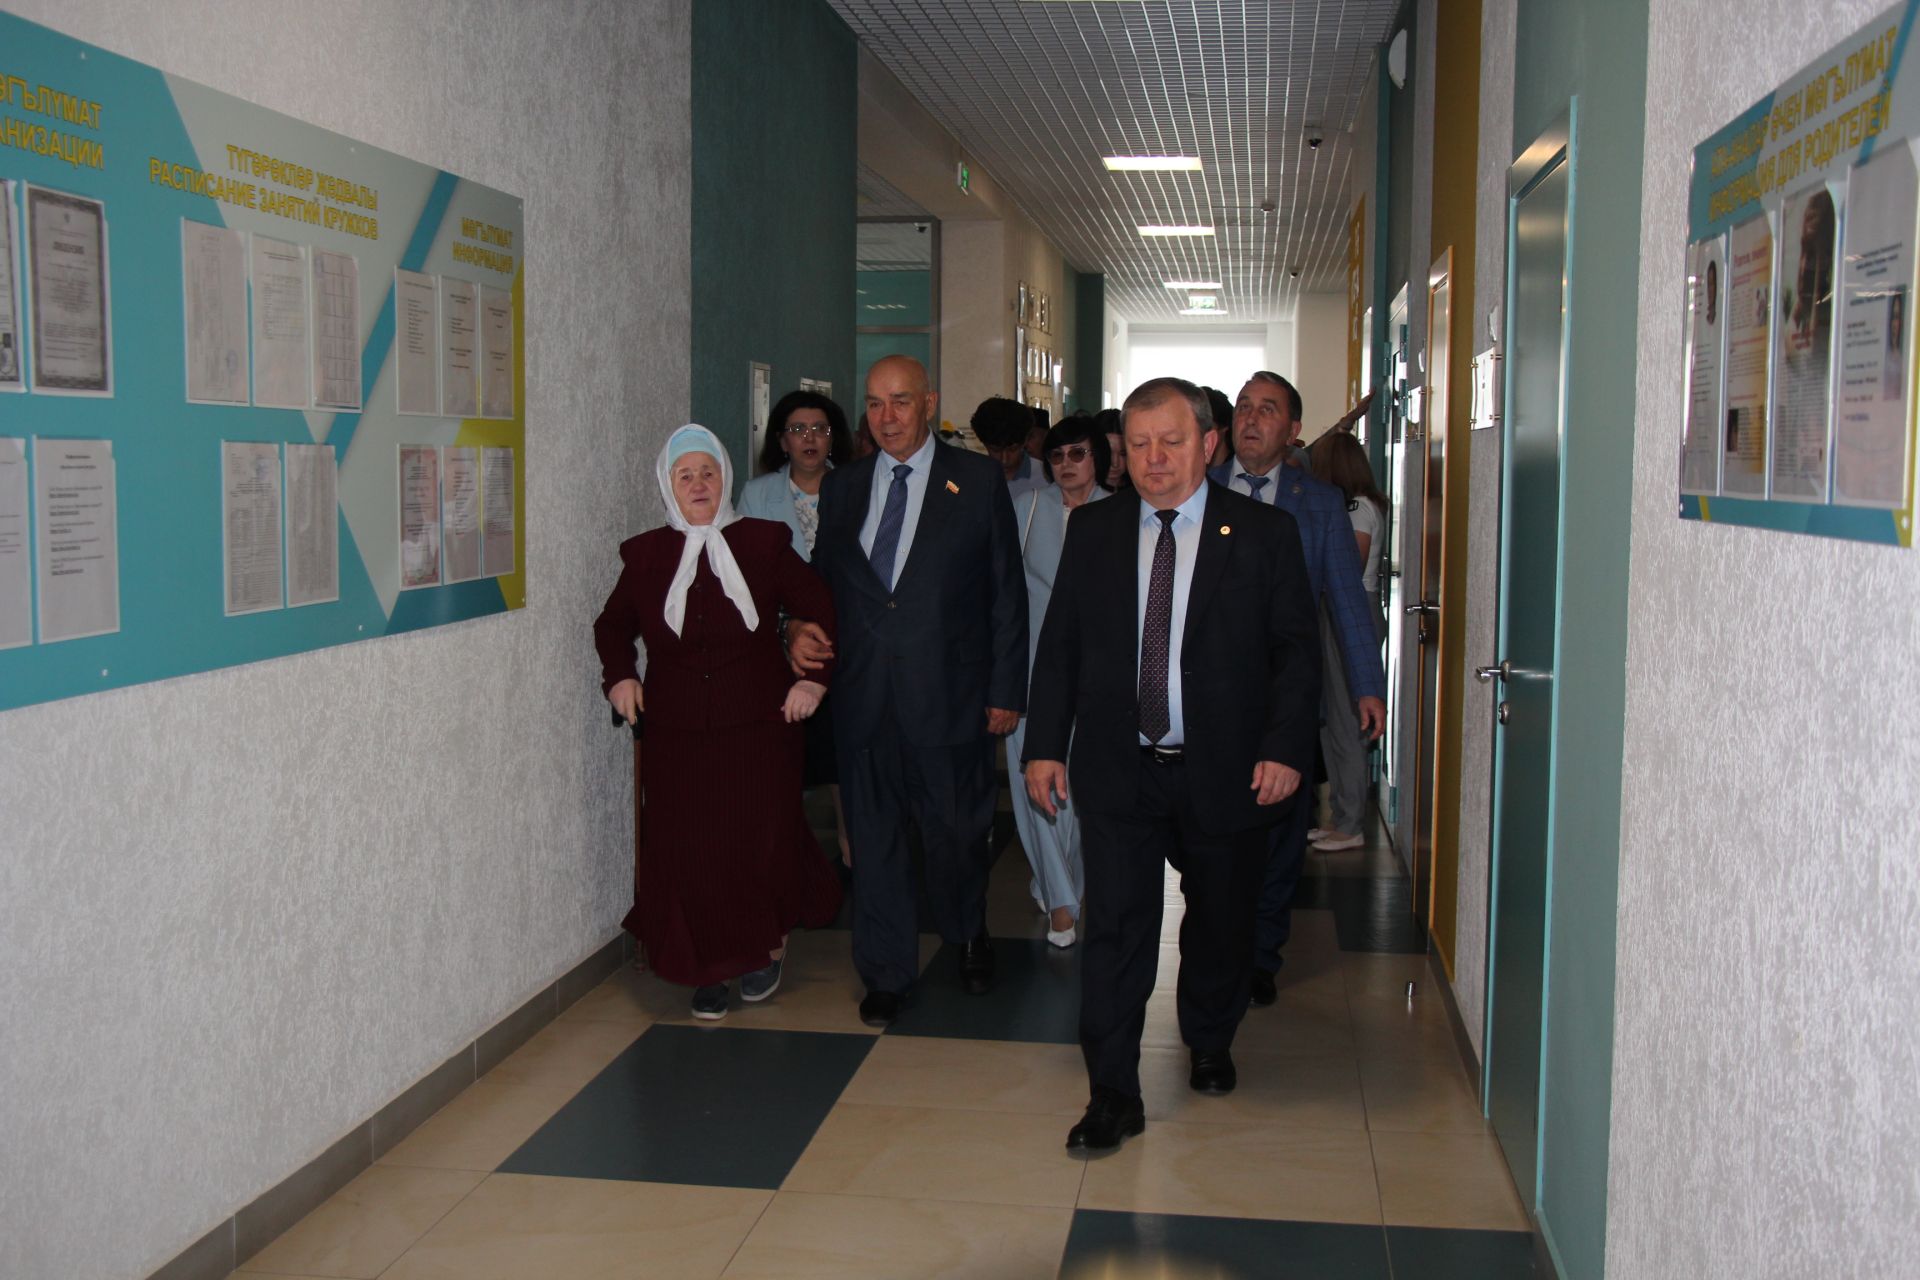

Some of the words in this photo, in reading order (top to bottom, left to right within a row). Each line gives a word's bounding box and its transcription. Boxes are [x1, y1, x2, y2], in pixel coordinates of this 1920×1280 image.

[226, 144, 314, 192] ТҮГӘРӘКЛӘР
[1776, 139, 1801, 193] ДЛЯ
[1804, 79, 1892, 173] РОДИТЕЛЕЙ
[150, 156, 257, 210] РАСПИСАНИЕ
[259, 186, 321, 226] ЗАНЯТИЙ
[323, 205, 379, 241] КРУЖКОВ
[453, 240, 514, 275] ИНФОРМАЦИЯ
